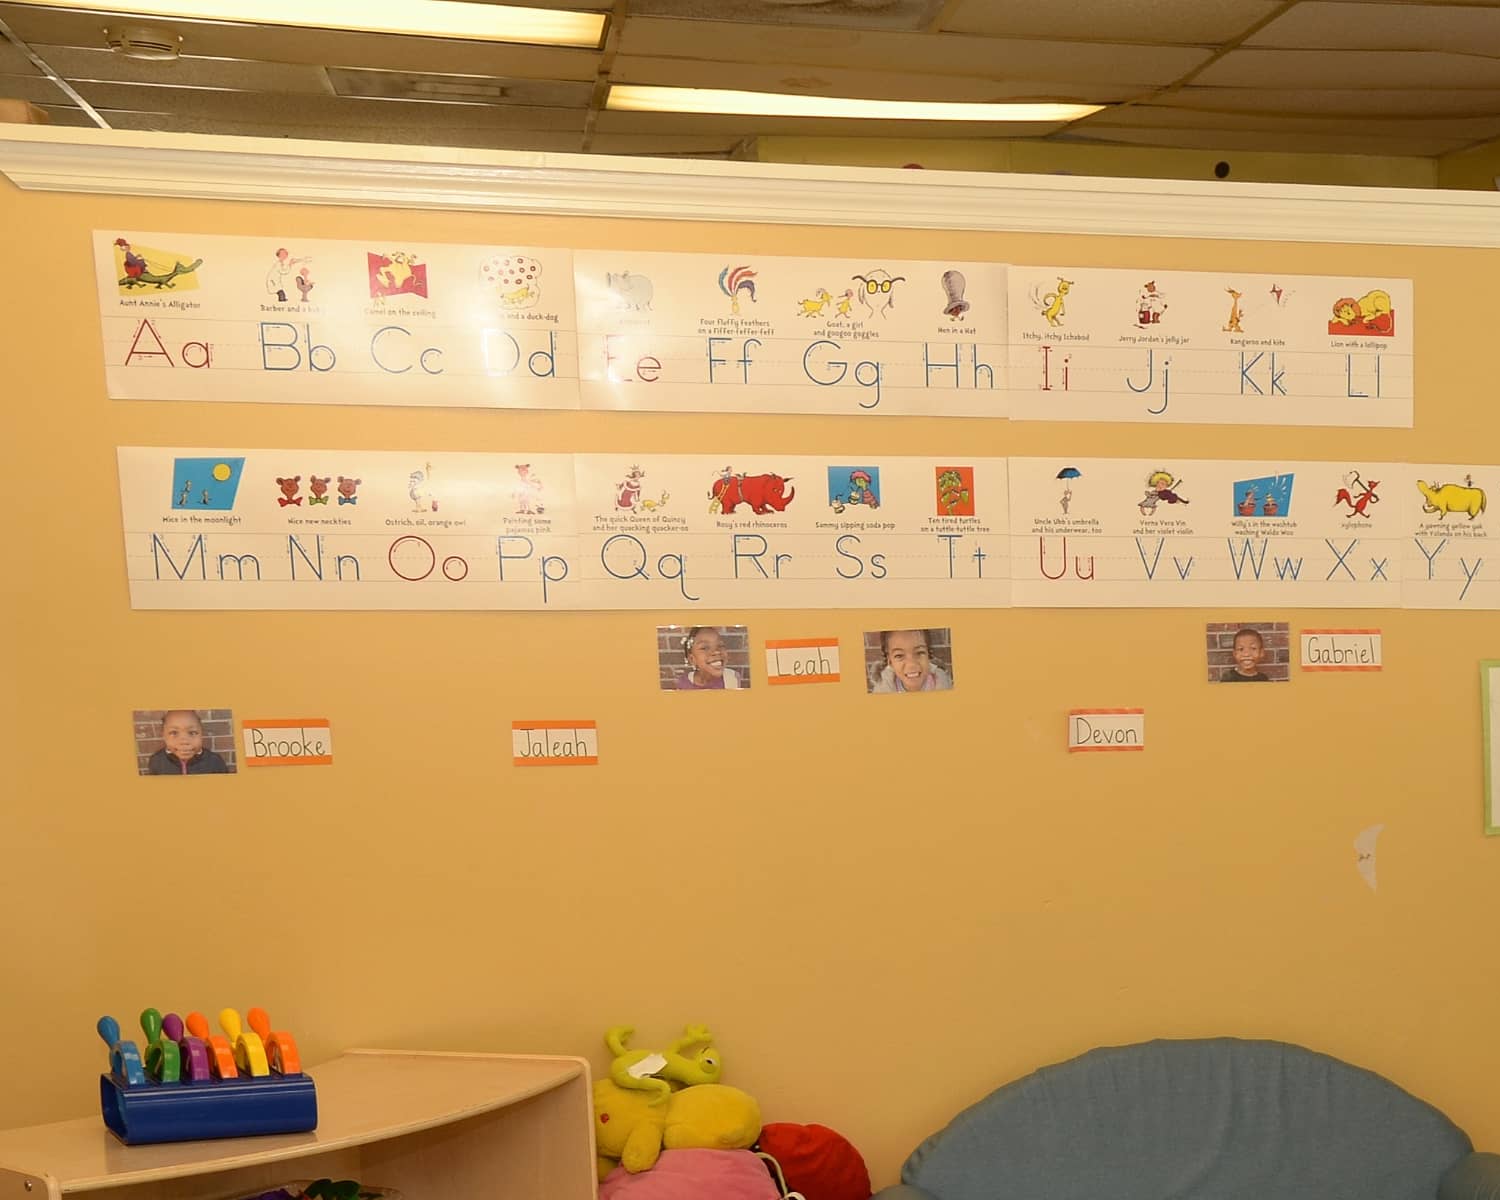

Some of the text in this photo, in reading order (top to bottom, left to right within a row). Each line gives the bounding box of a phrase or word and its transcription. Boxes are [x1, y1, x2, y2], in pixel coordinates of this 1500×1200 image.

[119, 299, 201, 311] Aunt Annie's Alligator
[399, 308, 411, 317] the
[1230, 338, 1259, 347] Kangaroo
[1364, 341, 1388, 350] lollipop
[125, 318, 211, 369] Aa
[260, 321, 336, 372] Bb
[370, 325, 444, 375] Cc
[707, 337, 762, 384] Ff
[803, 339, 880, 409] Gg
[924, 341, 994, 389] Hh
[1041, 345, 1070, 391] Ii
[1126, 348, 1169, 415] Jj
[1240, 351, 1287, 396] Kk
[1346, 353, 1380, 398] Ll
[190, 516, 202, 524] the
[204, 516, 242, 526] moonlight
[595, 515, 607, 523] The
[609, 515, 628, 525] quick
[629, 515, 650, 524] Queen
[652, 515, 660, 523] of
[739, 520, 751, 528] red
[752, 521, 788, 529] rhinoceros
[942, 517, 957, 525] tired
[959, 517, 981, 525] turtles
[1034, 518, 1052, 526] Uncle
[1072, 518, 1099, 526] umbrella
[592, 524, 605, 532] and
[815, 521, 896, 531] Sammy sipping soda pop
[1032, 526, 1044, 534] and
[1045, 526, 1054, 534] his
[152, 532, 261, 581] Mm
[288, 533, 362, 581] Nn
[388, 534, 469, 582] Oo
[497, 535, 568, 604] Pp
[600, 533, 700, 601] Qq
[733, 533, 793, 579] Rr
[835, 534, 888, 579] Ss
[937, 534, 987, 579] Tt
[1039, 535, 1095, 580] Uu
[1135, 537, 1193, 580] Vv
[1227, 537, 1303, 581] Ww
[1324, 538, 1388, 581] Xx
[1414, 538, 1482, 601] Yy
[1307, 636, 1376, 664] Gabriel
[775, 647, 831, 677] Leah
[1076, 717, 1138, 745] Devon
[251, 728, 326, 758] Brooke
[519, 728, 588, 759] Jaleah
